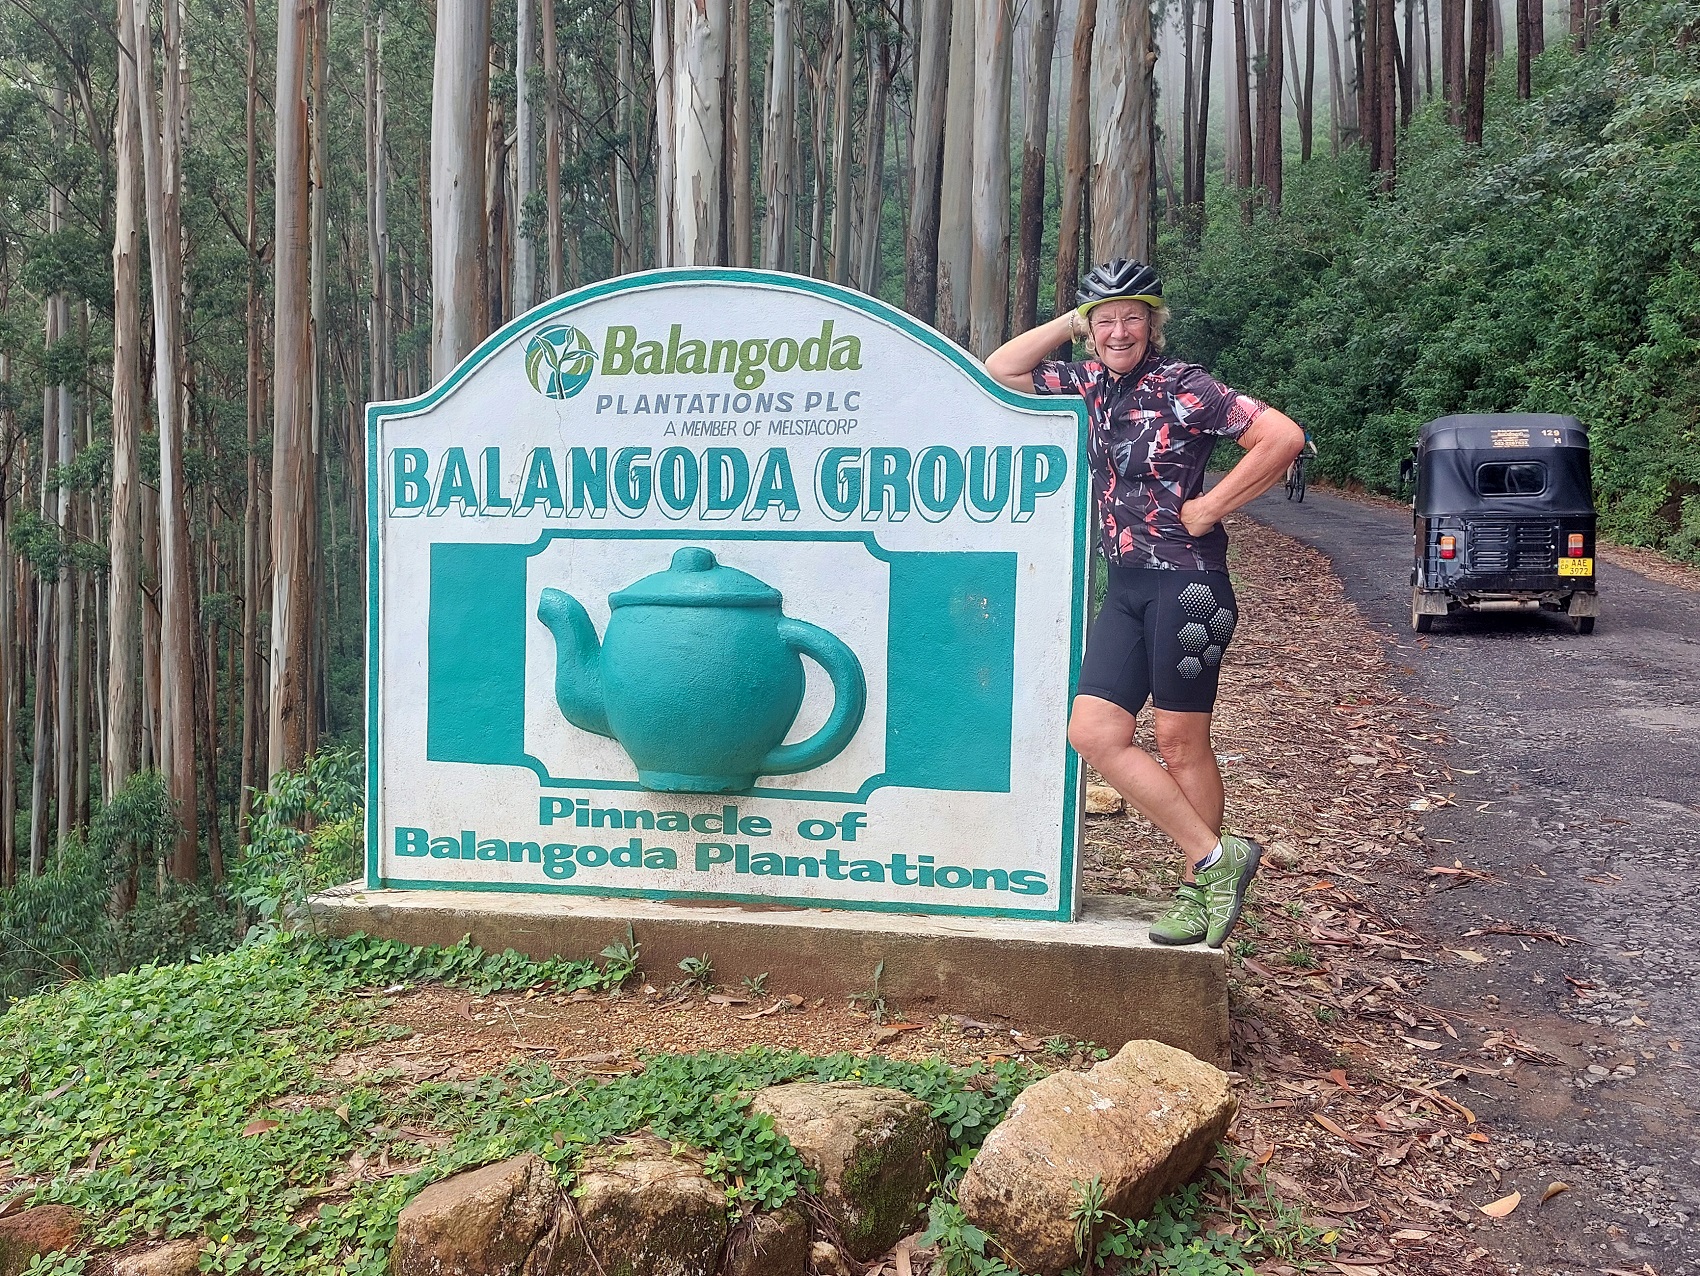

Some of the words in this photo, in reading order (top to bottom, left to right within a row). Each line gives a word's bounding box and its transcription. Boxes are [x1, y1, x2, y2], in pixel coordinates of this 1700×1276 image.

[600, 319, 863, 391] Balangoda
[595, 392, 795, 415] PLANTATIONS
[804, 391, 861, 412] PLC
[663, 420, 677, 437] A
[681, 420, 737, 437] MEMBER
[743, 420, 762, 436] OF
[768, 418, 858, 436] MELSTACORP
[388, 446, 801, 521] BALANGODA
[813, 445, 1068, 523] GROUP
[539, 796, 772, 838] Pinnacle
[797, 811, 868, 842] of
[395, 826, 678, 880] Balangoda
[695, 842, 1048, 896] Plantations
